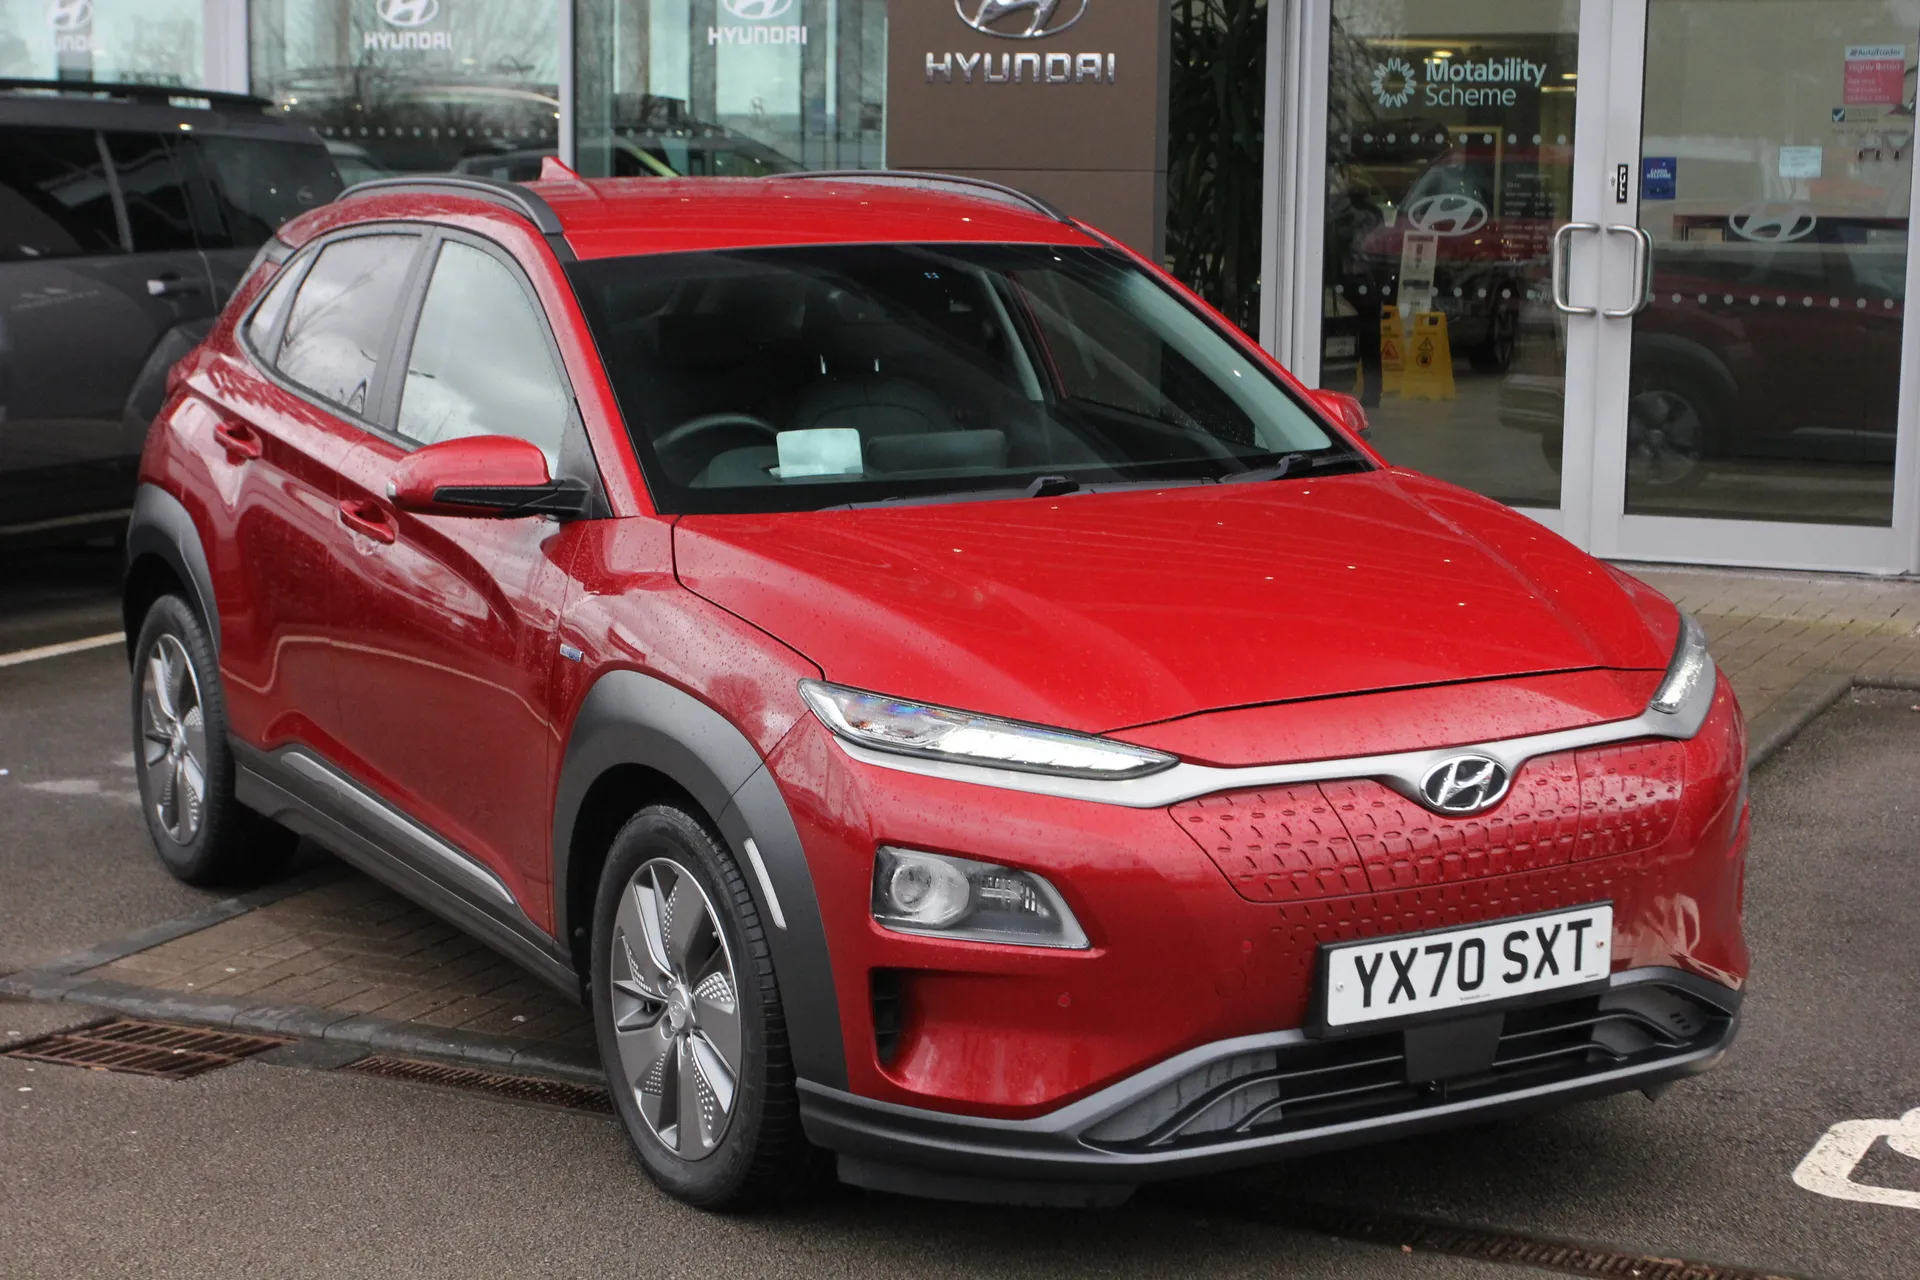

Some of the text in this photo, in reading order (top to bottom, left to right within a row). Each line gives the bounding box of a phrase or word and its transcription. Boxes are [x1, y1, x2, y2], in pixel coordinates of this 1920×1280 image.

[363, 31, 453, 50] HYUNDAI
[707, 25, 808, 45] HYUNDAI
[925, 52, 1116, 84] HYUNDAI
[1426, 57, 1547, 88] Motability
[1425, 83, 1517, 107] Scheme
[1353, 918, 1593, 1009] YX70 SXT
